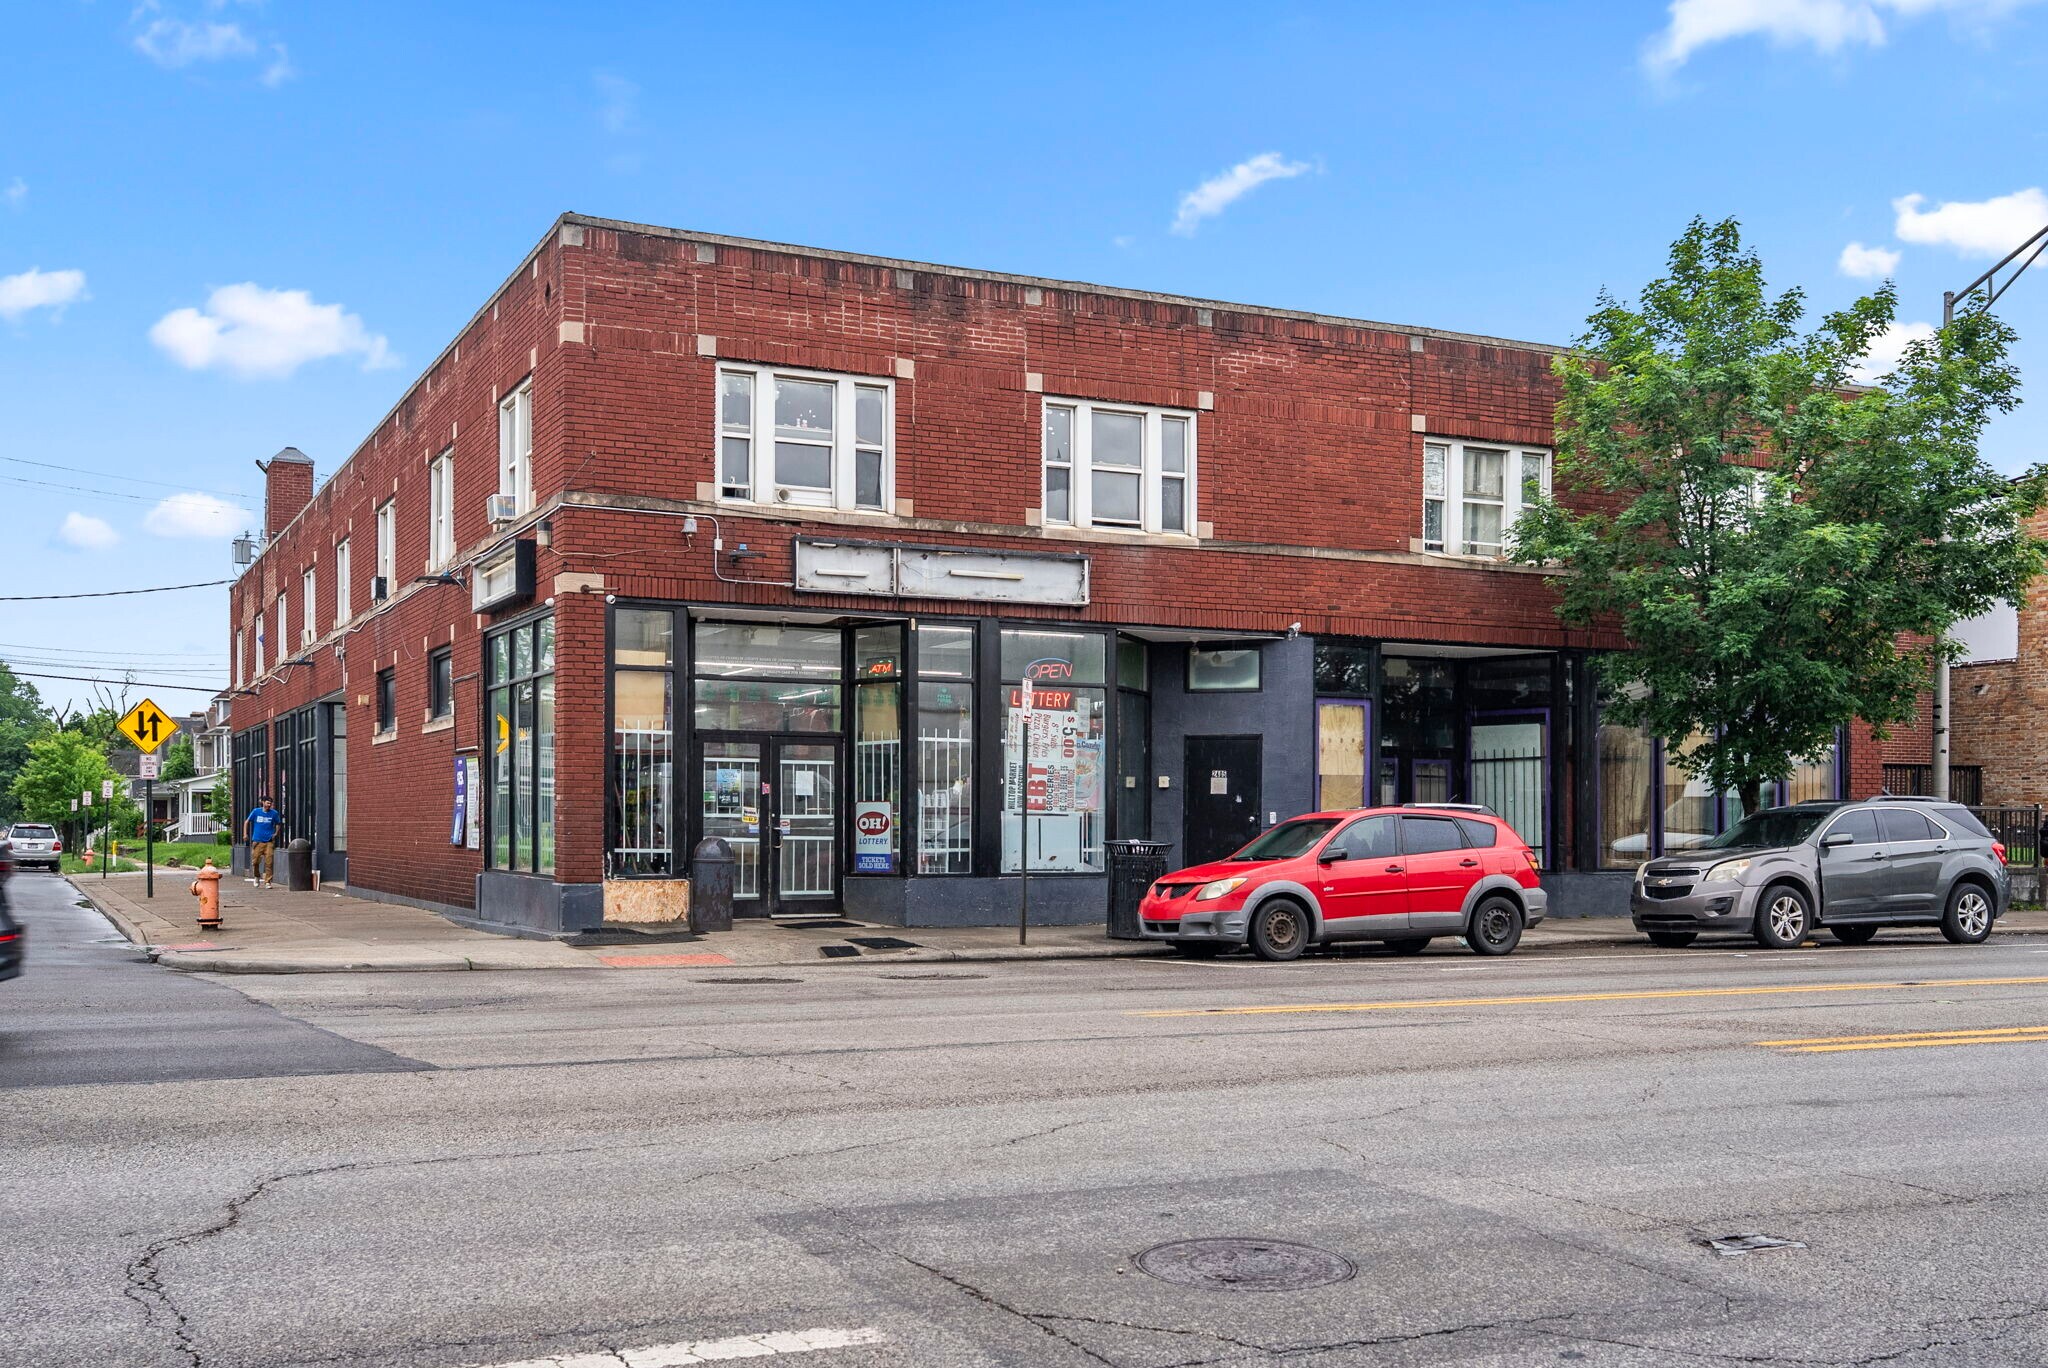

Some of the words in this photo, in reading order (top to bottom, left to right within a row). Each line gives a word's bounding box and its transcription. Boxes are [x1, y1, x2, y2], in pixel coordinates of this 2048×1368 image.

[871, 663, 892, 673] ATM
[1028, 664, 1073, 679] OPEN
[1011, 690, 1071, 708] LTTERY
[1008, 762, 1017, 785] MARKET
[1027, 763, 1047, 810] EBT
[1046, 765, 1055, 811] GROCERIES
[1007, 786, 1016, 809] HILLTOP
[859, 815, 887, 830] OH!
[859, 837, 888, 845] LOTTERY
